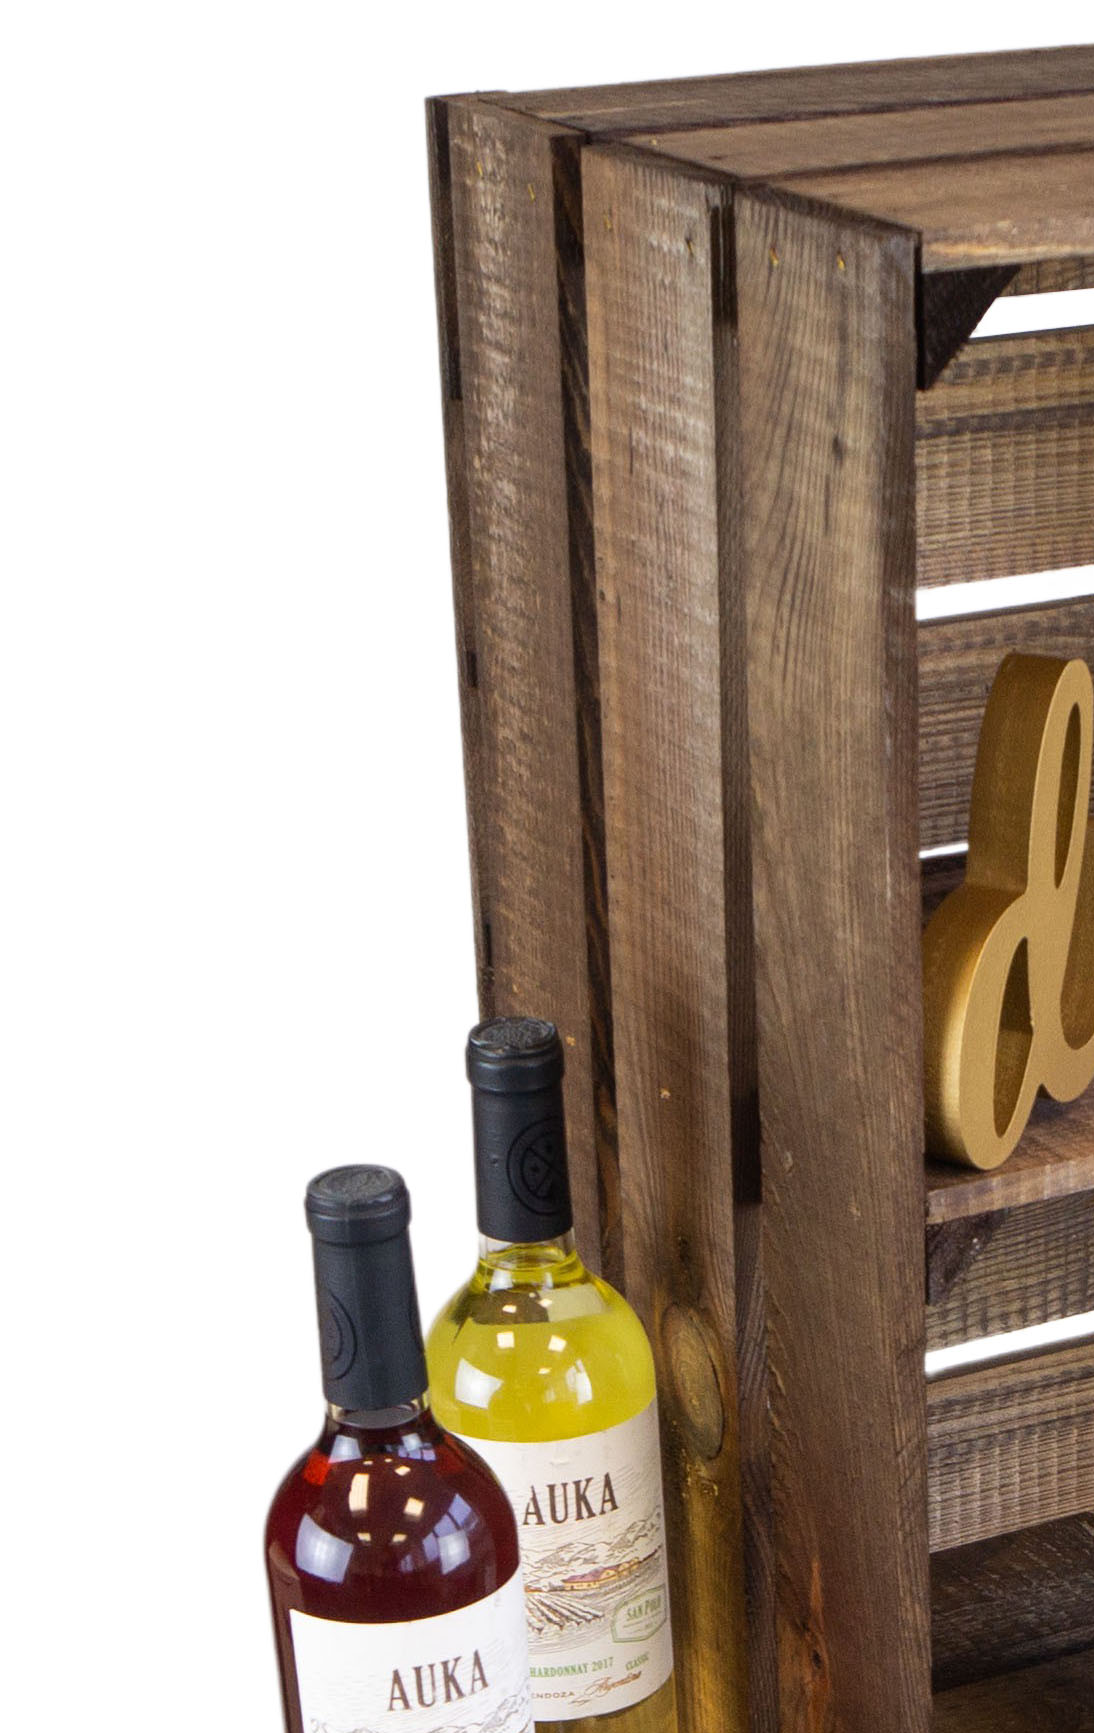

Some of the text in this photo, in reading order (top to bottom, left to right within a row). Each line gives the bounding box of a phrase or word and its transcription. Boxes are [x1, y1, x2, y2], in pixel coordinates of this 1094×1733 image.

[522, 1472, 619, 1526] AUKA
[387, 1649, 490, 1712] AUKA
[529, 1656, 614, 1678] HARDONNAY 2017
[530, 1690, 576, 1700] ENDOZA
